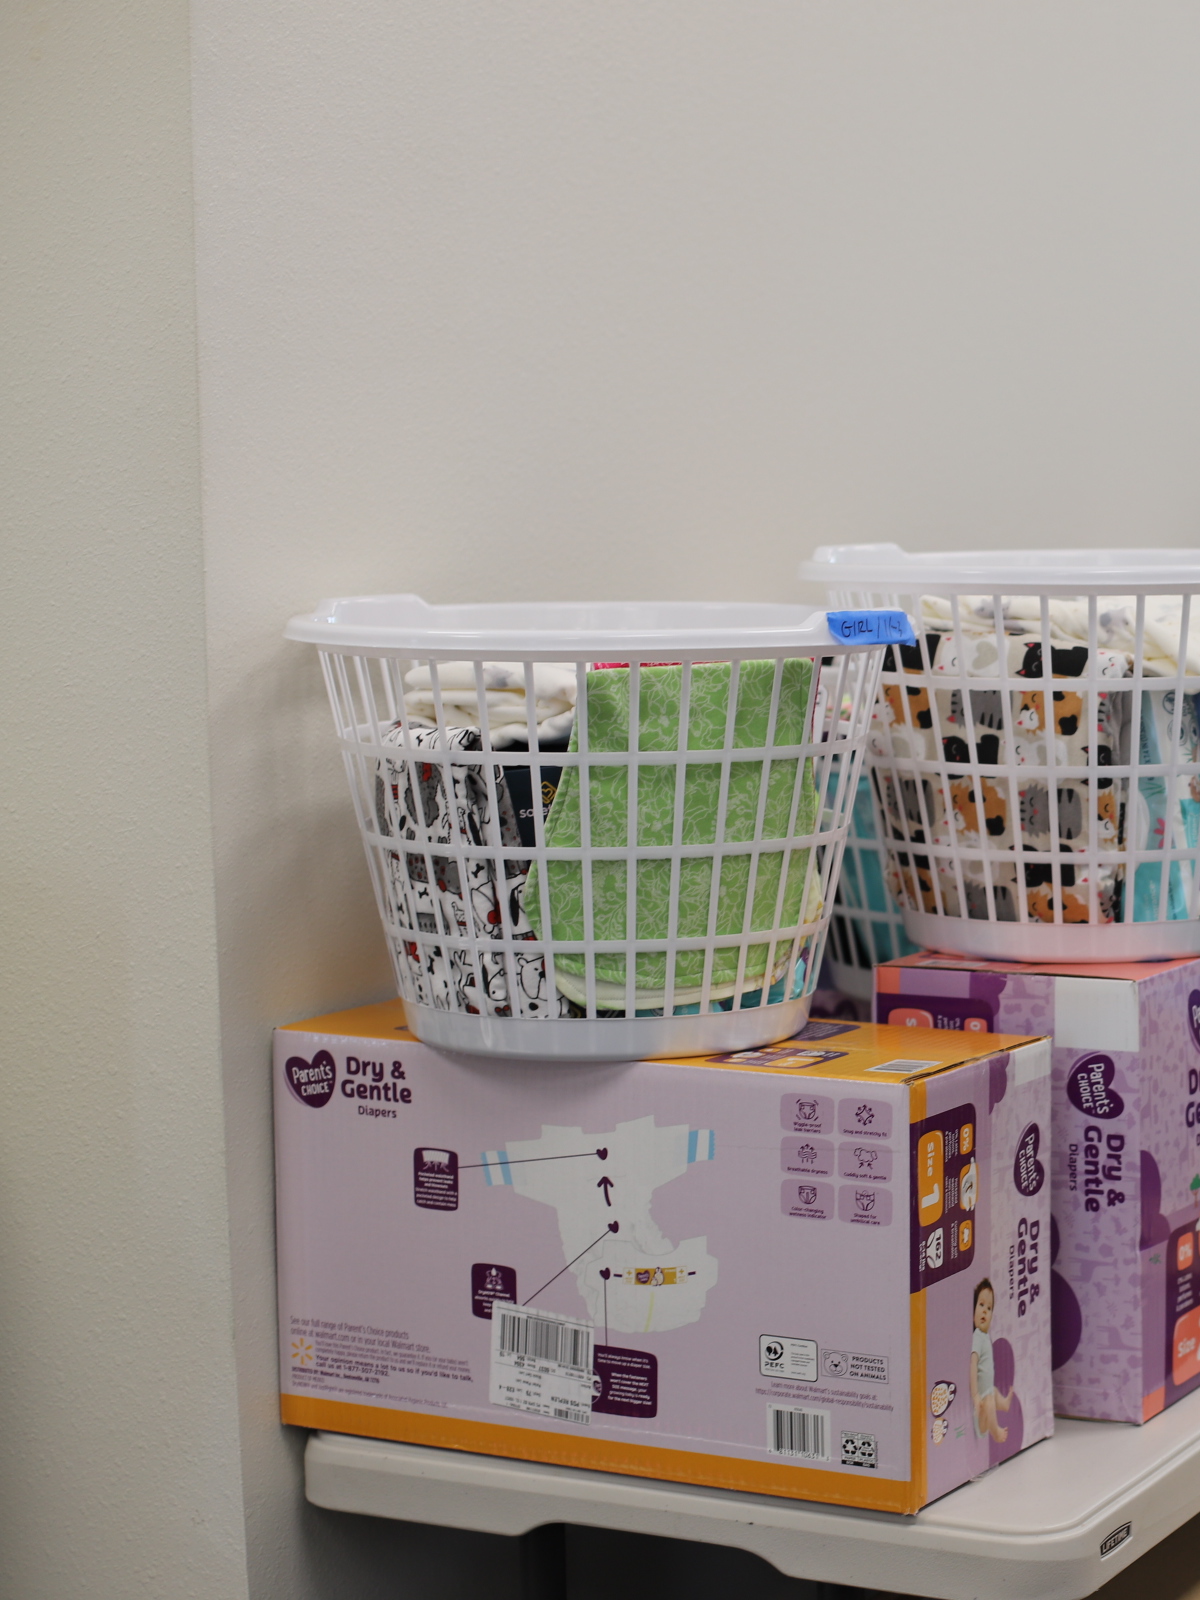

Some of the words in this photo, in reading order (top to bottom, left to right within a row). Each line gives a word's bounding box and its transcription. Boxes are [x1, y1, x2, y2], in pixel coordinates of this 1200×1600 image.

[841, 618, 873, 638] GIRL
[291, 1060, 333, 1084] Parent's
[346, 1056, 384, 1082] Dry
[390, 1060, 406, 1080] &
[301, 1081, 330, 1096] CHOICE
[341, 1079, 412, 1104] Gentle
[1077, 1073, 1094, 1109] CHOICE
[1087, 1063, 1114, 1114] Parent's
[358, 1105, 397, 1118] Diapers
[963, 1127, 970, 1152] 0%
[927, 1141, 935, 1177] Size
[1019, 1149, 1029, 1190] CHOICE
[1025, 1133, 1039, 1191] Parent's
[1068, 1143, 1078, 1192] Diapers
[1084, 1125, 1105, 1213] Gentle
[1102, 1133, 1125, 1182] Dry
[921, 1183, 940, 1209] 1
[1106, 1189, 1126, 1208] &
[1027, 1219, 1040, 1275] Dry
[1008, 1244, 1016, 1300] Diapers
[1017, 1217, 1029, 1318] Gentle
[1029, 1283, 1040, 1305] &
[321, 1321, 337, 1331] range
[367, 1325, 385, 1336] Choice
[764, 1361, 785, 1369] PEFC
[852, 1356, 884, 1365] PRODUCTS
[864, 1365, 885, 1373] TESTED
[860, 1372, 887, 1381] ANIMALS
